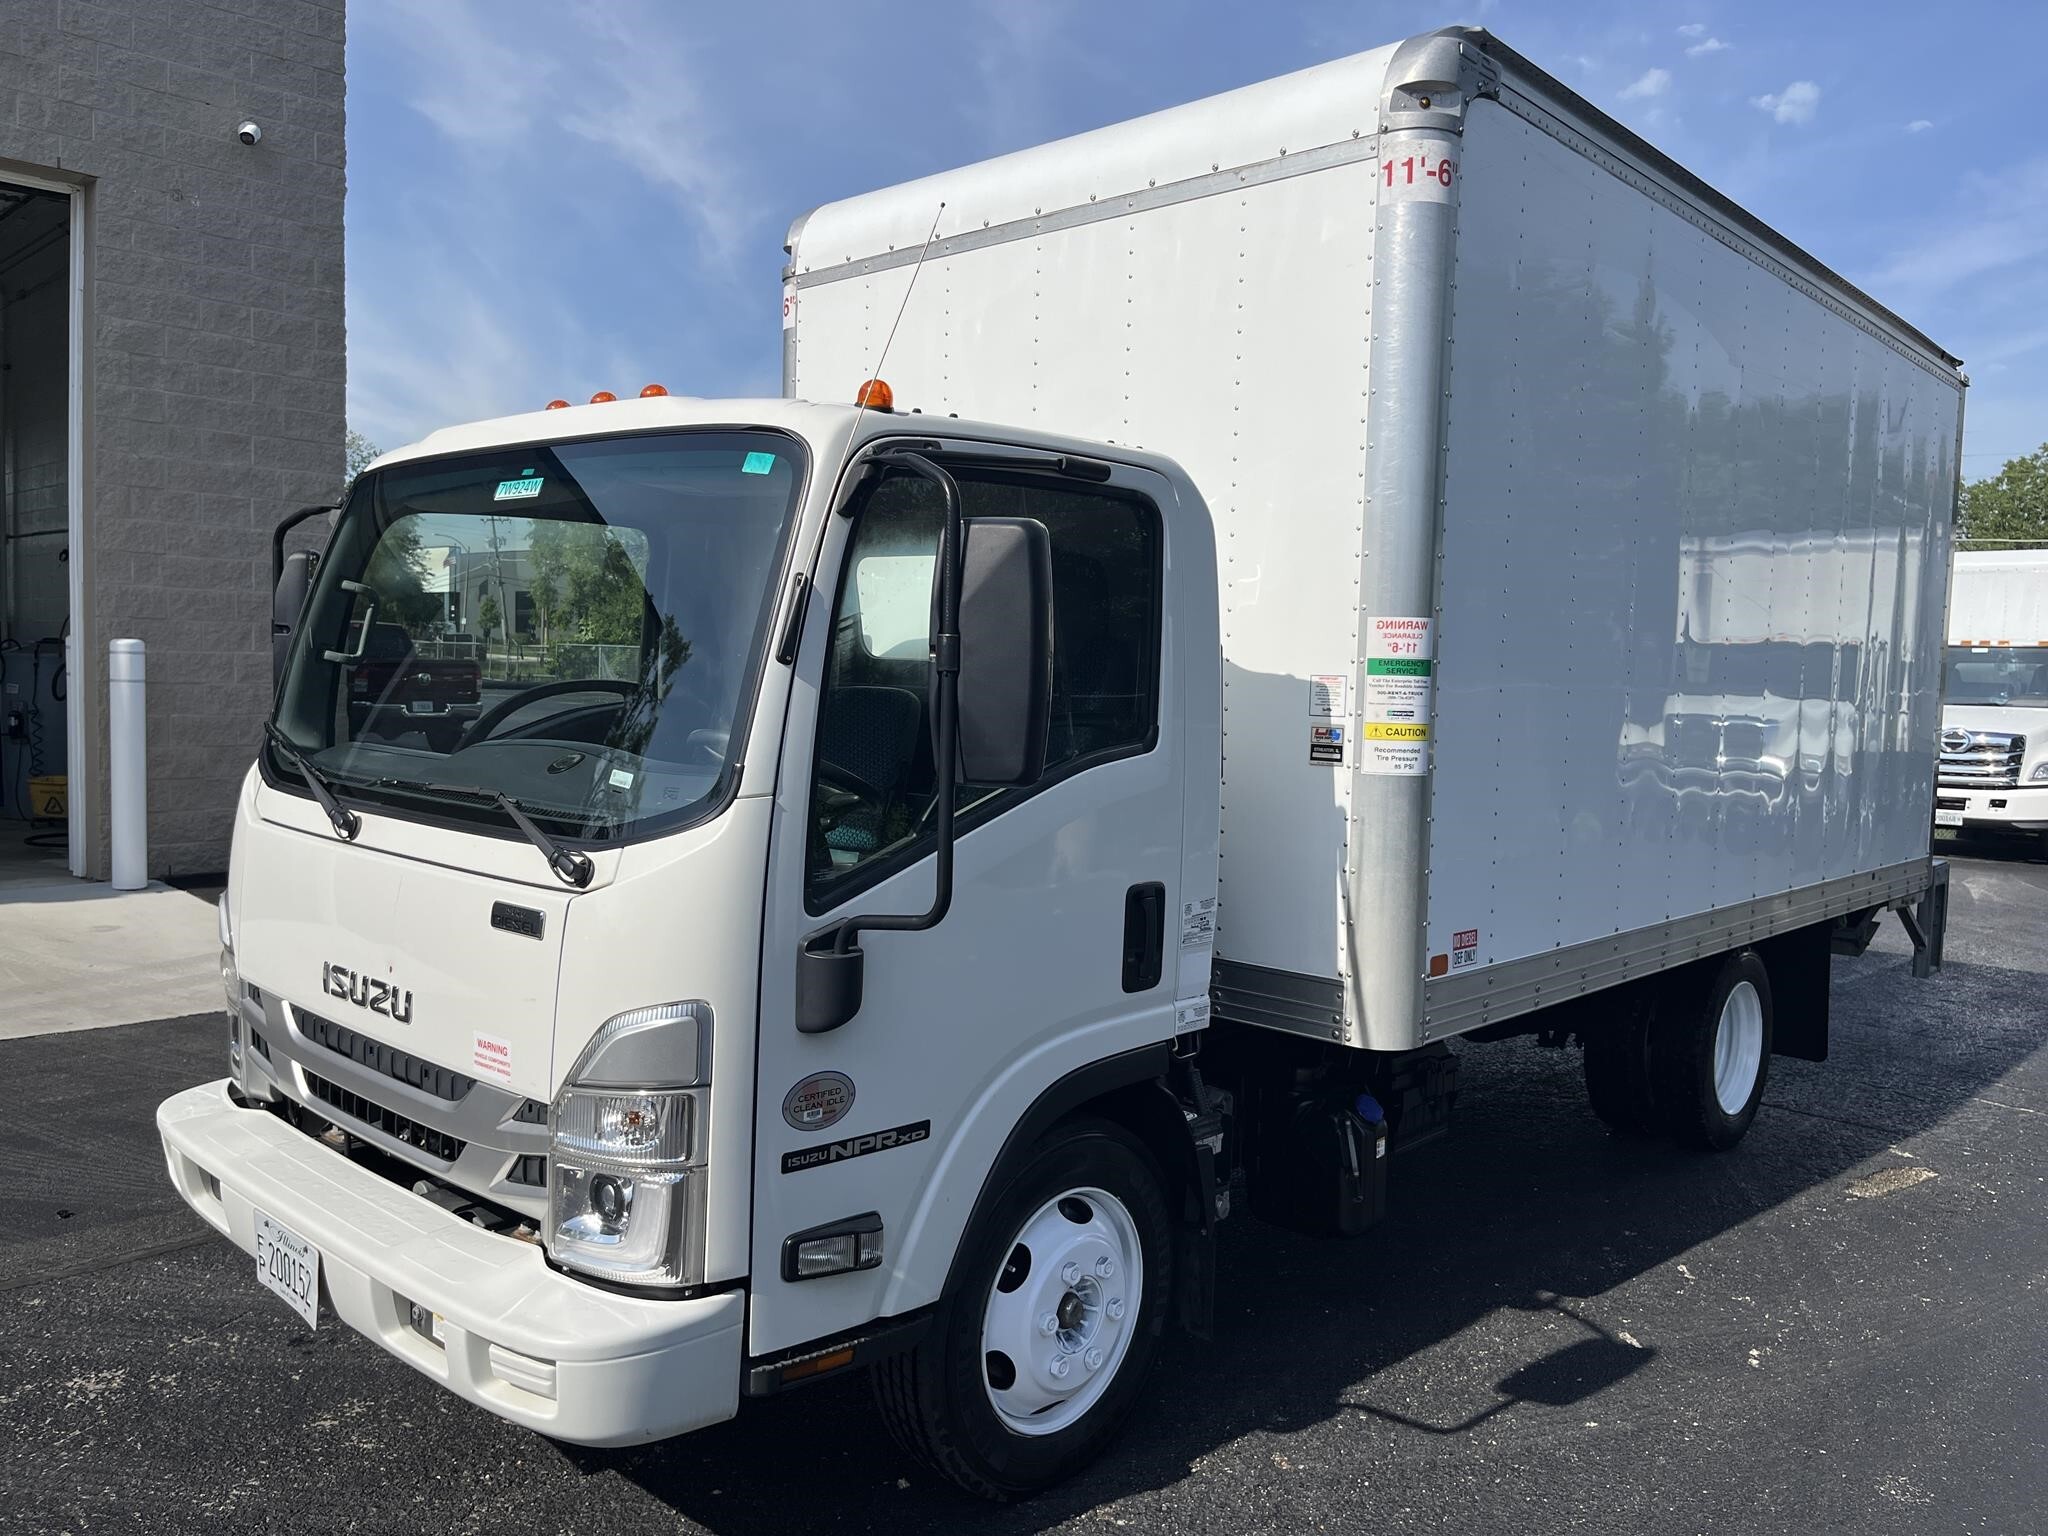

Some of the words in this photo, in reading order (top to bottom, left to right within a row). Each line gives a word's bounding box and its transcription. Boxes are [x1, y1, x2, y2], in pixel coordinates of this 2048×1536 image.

[1378, 659, 1425, 668] EMERGENCY
[1385, 667, 1418, 675] SERVICE
[1385, 728, 1427, 737] CAUTION
[1374, 747, 1421, 755] Recommended
[323, 960, 414, 1026] ISUZU
[477, 1038, 508, 1057] WARNING
[798, 1087, 842, 1103] CERTIFIED
[793, 1101, 823, 1114] CLEAN
[826, 1095, 846, 1107] IDLE
[787, 1150, 828, 1168] ISUZU
[268, 1242, 311, 1308] 200152
